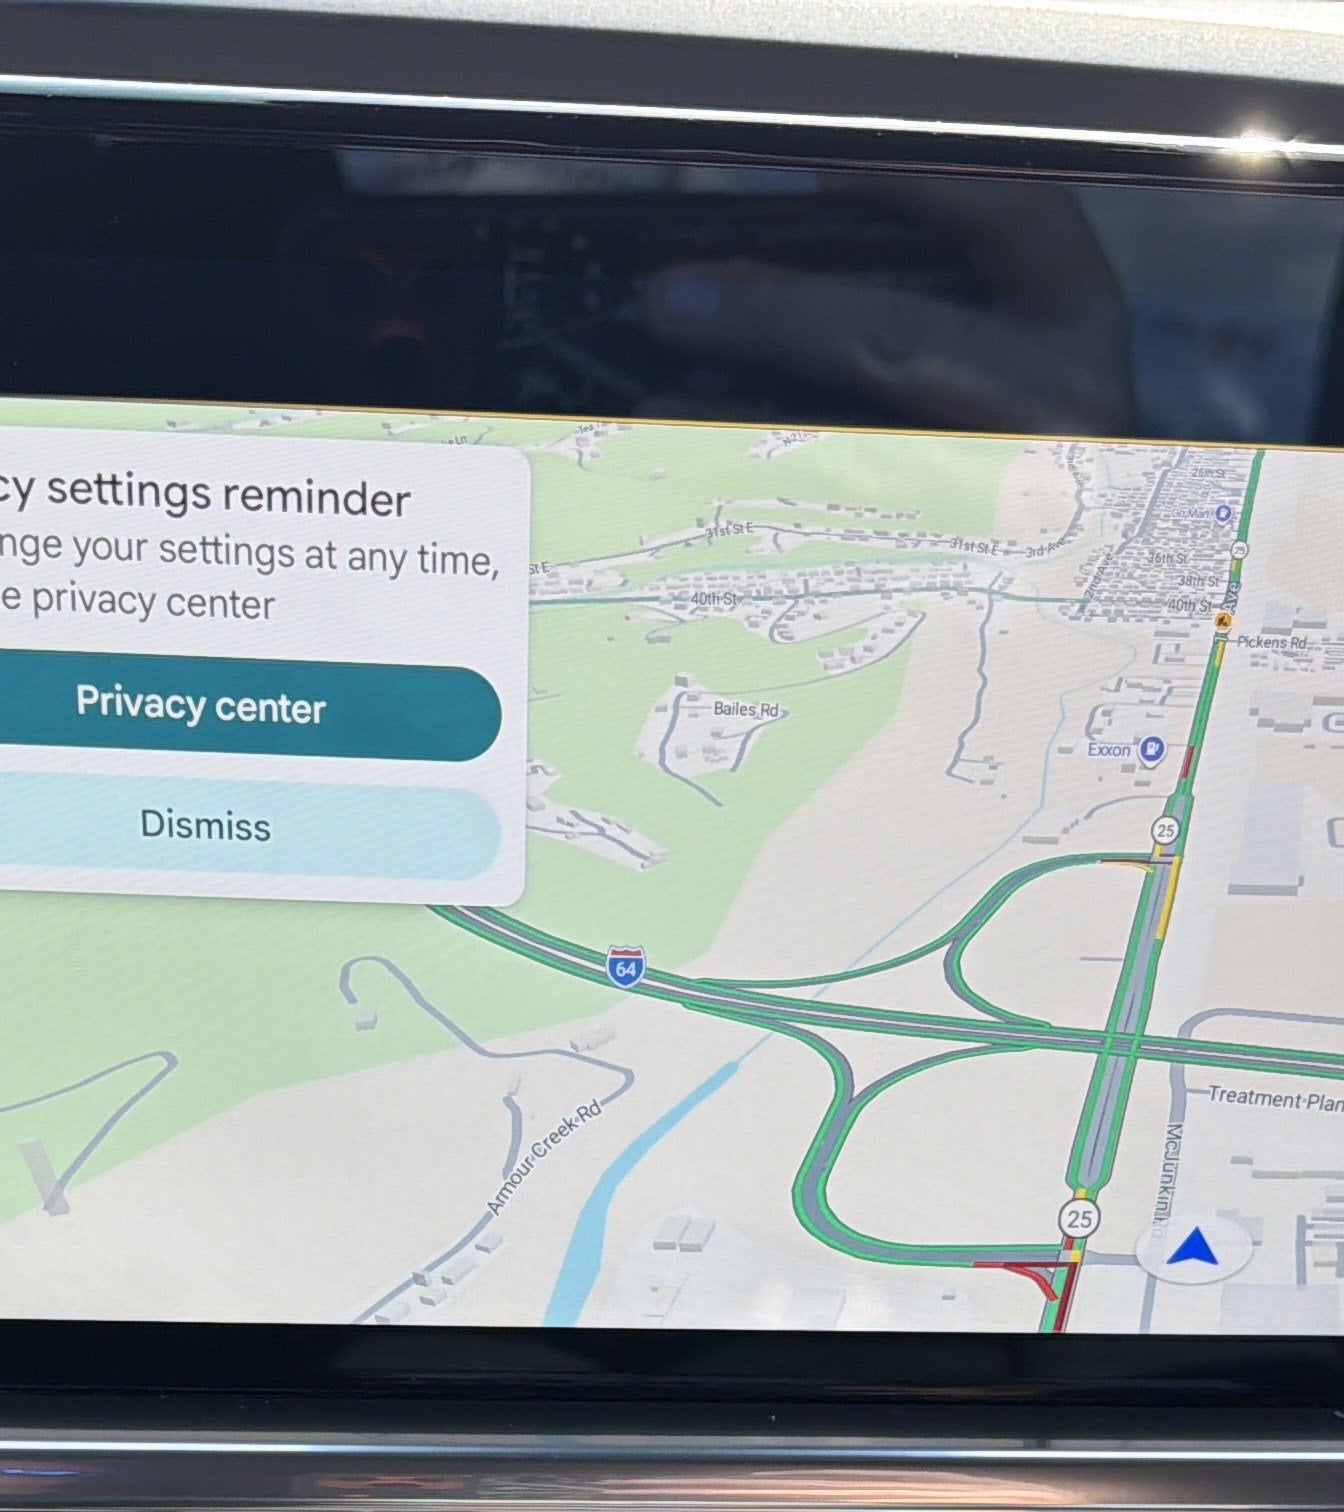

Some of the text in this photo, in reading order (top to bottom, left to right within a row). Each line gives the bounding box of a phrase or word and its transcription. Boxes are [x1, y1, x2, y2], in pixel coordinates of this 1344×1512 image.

[47, 471, 211, 518] settings
[224, 478, 411, 517] reminder
[706, 522, 754, 539] 31st St E
[950, 538, 999, 556] 31st St E
[1026, 537, 1067, 558] 3rd Ave
[1233, 546, 1246, 555] 25
[72, 537, 148, 567] your
[159, 533, 295, 575] settings
[305, 541, 337, 569] at
[348, 547, 407, 580] any
[417, 541, 499, 581] time,
[1176, 553, 1189, 564] St
[1085, 553, 1115, 598] 2nd Ave
[1179, 575, 1220, 587] 38th St
[33, 580, 156, 622] privacy
[167, 591, 276, 619] center
[691, 592, 737, 605] 40th St
[1168, 599, 1213, 612] 40th St
[1237, 636, 1288, 649] Pickens
[1291, 637, 1307, 649] Rd
[76, 683, 327, 727] Privacy center
[713, 702, 780, 718] Bailes Rd
[1087, 742, 1131, 758] Exxon
[141, 807, 271, 841] Dismiss
[1155, 823, 1175, 839] 25
[616, 961, 637, 978] 64
[1209, 1085, 1302, 1109] Treatment
[487, 1098, 602, 1216] Armour Creek Rd
[1156, 1124, 1183, 1217] McJunkin
[1067, 1209, 1093, 1228] 25
